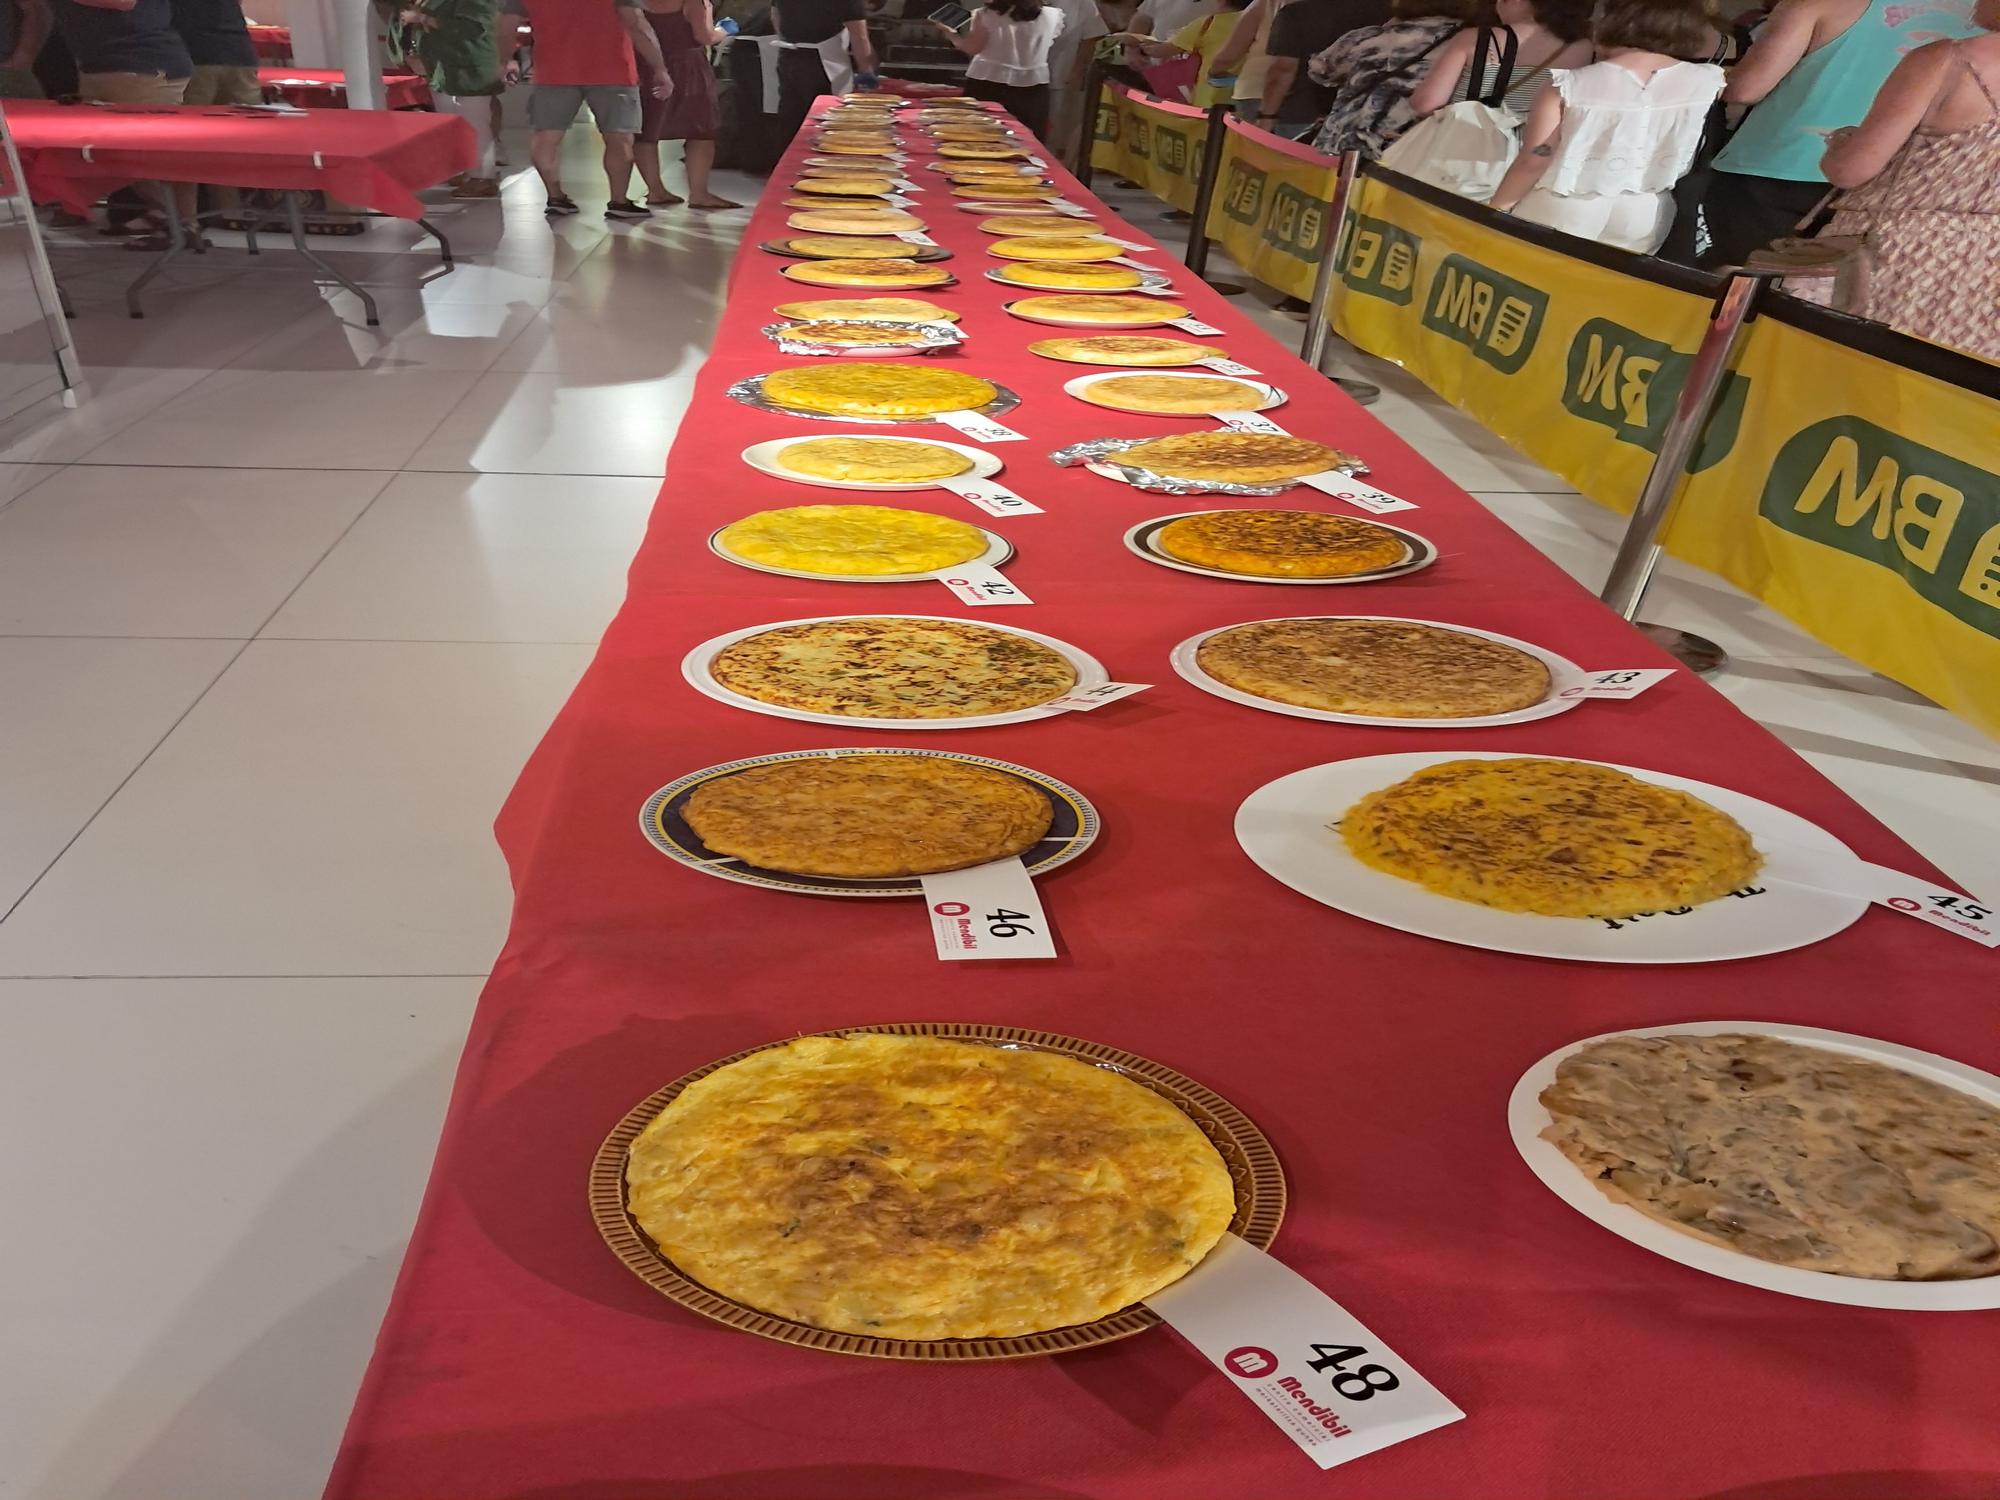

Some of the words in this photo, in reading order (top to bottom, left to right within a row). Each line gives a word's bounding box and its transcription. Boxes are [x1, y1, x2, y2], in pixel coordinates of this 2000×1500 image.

[1250, 421, 1279, 433] 37
[992, 493, 1024, 507] 40
[1360, 491, 1397, 504] 39
[981, 581, 1016, 596] 42
[1594, 671, 1642, 684] 43
[1084, 684, 1127, 697] 44
[1926, 895, 1993, 921] 45
[985, 907, 1036, 938] 46
[1305, 1343, 1400, 1402] 48
